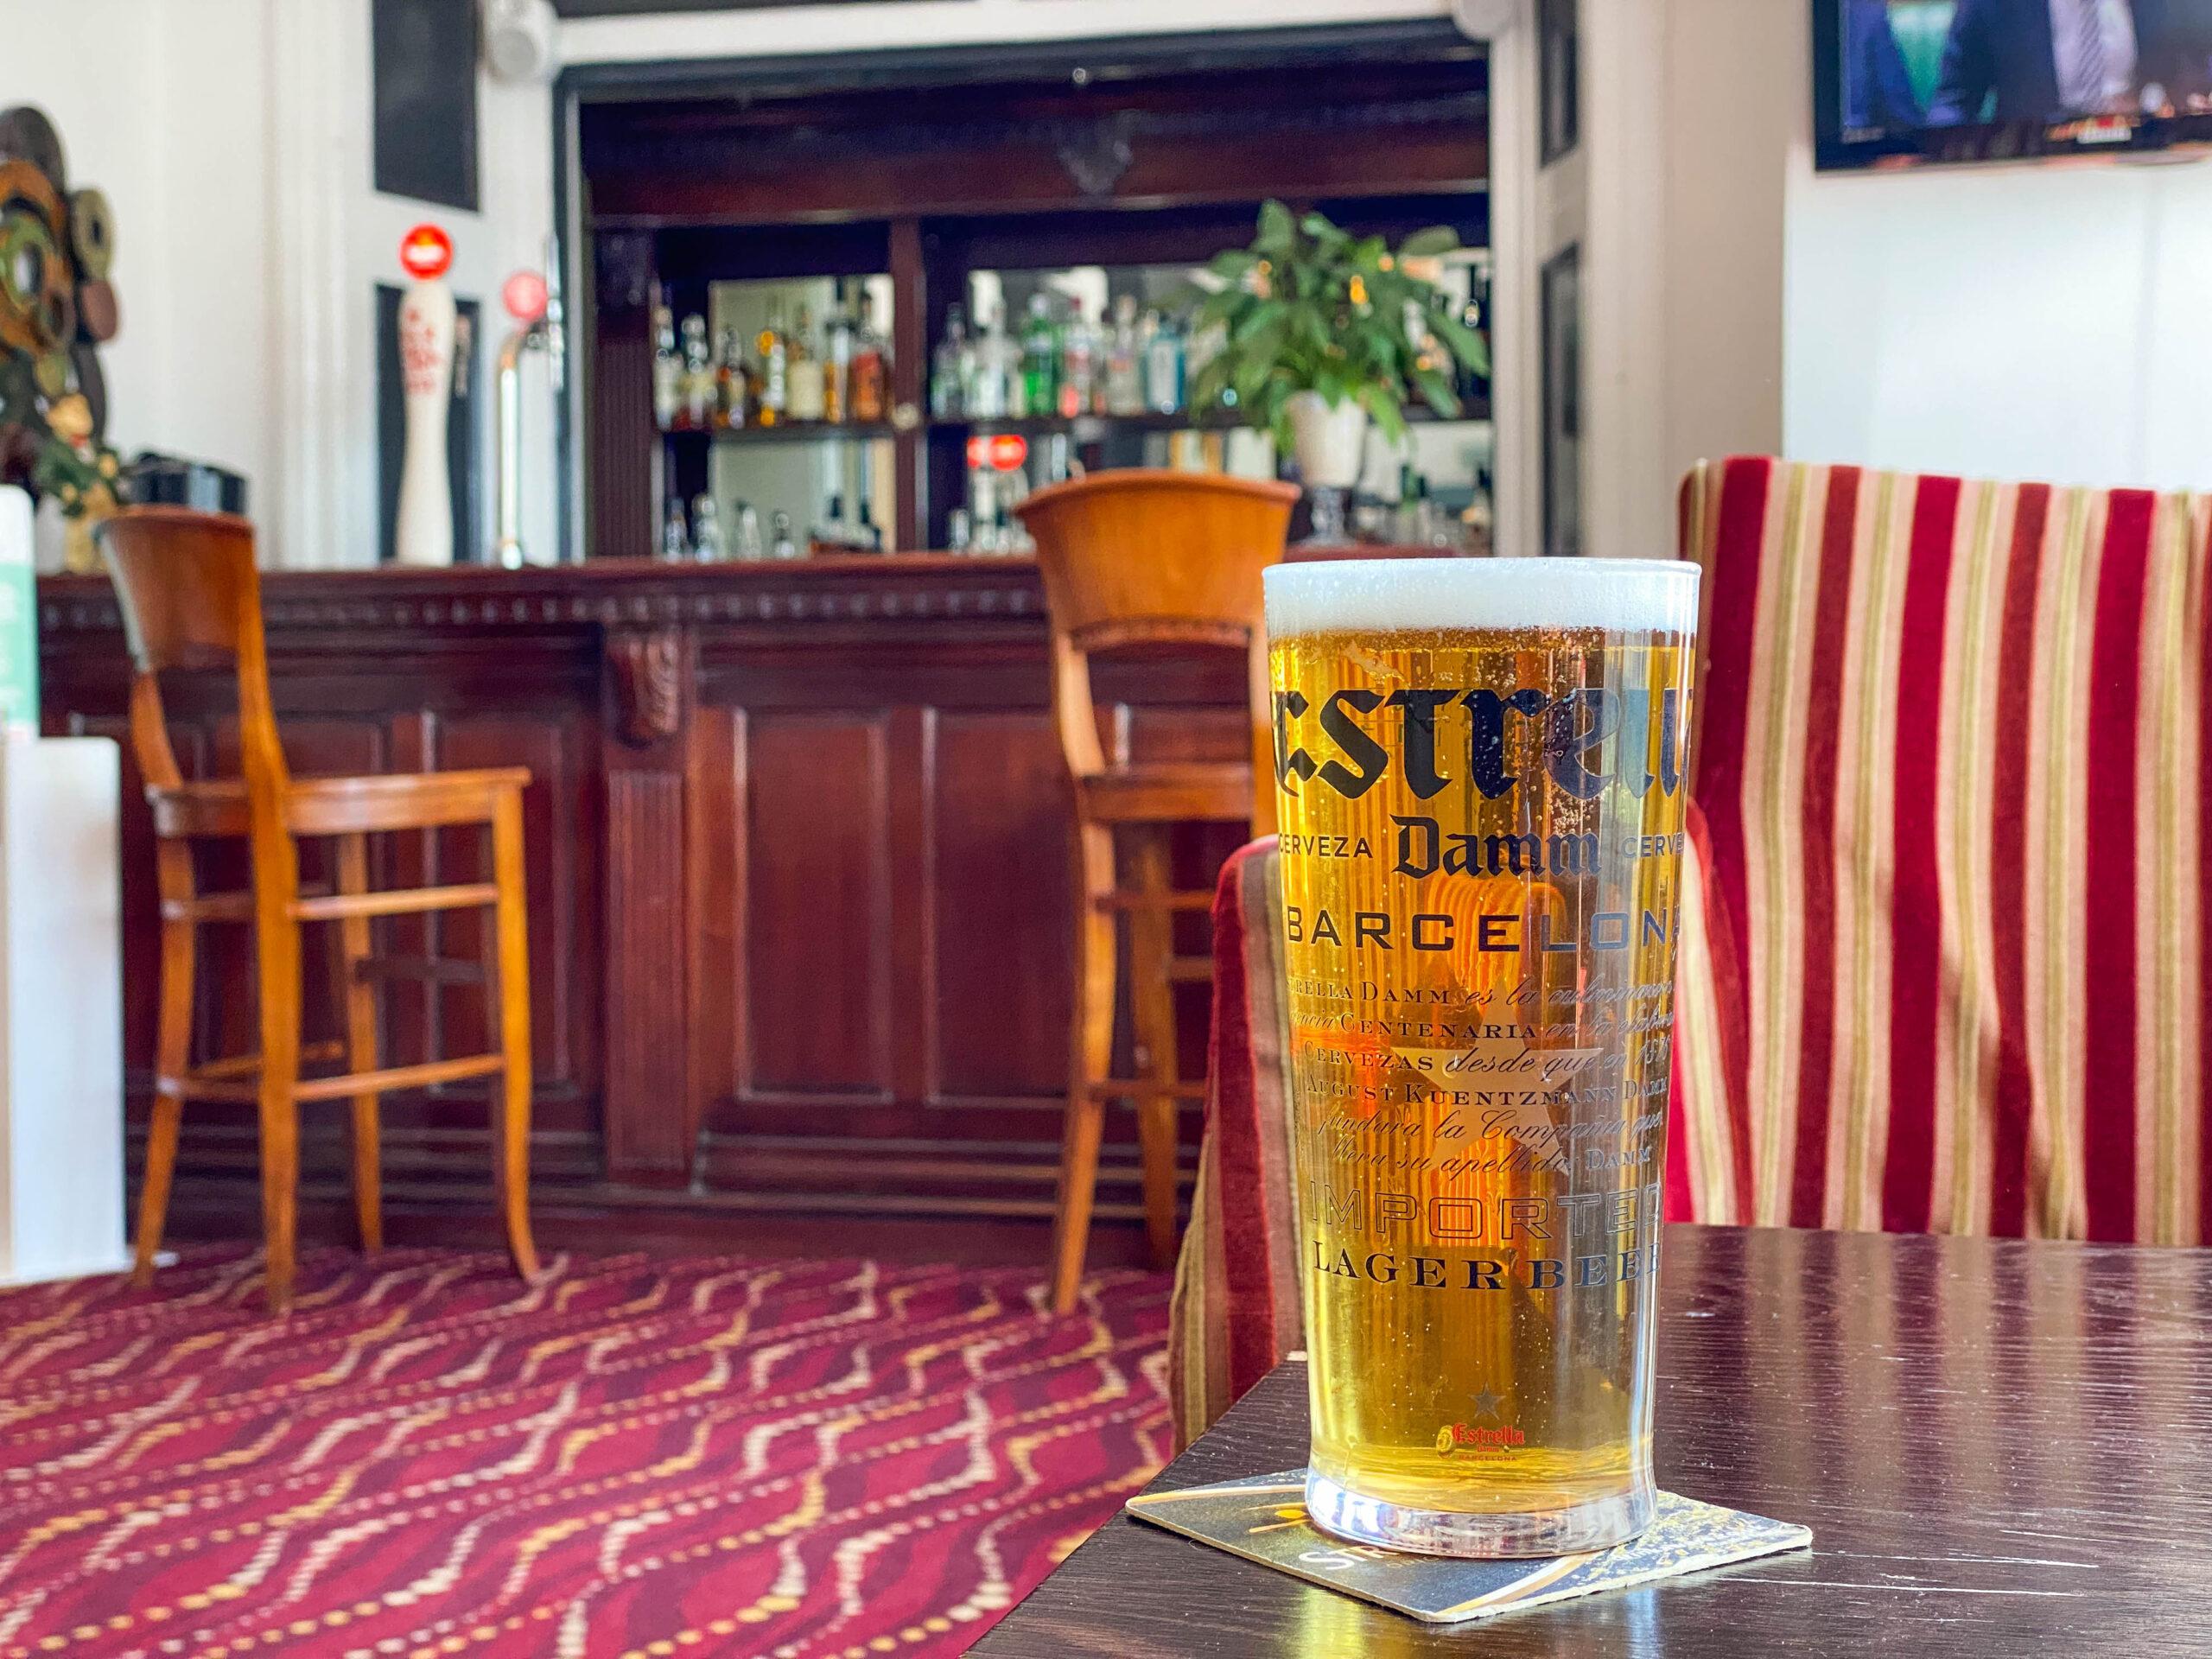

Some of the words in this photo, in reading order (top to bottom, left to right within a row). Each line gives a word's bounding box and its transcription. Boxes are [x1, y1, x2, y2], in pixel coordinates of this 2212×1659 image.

[1279, 832, 1373, 859] CERVEZA
[1389, 814, 1602, 879] Damm
[1360, 981, 1450, 1004] DAMM
[1465, 989, 1497, 1006] es
[1505, 975, 1541, 1006] la
[1340, 1013, 1536, 1039] CENTENARIA
[1304, 1039, 1433, 1071] CERVEZAS
[1445, 1046, 1536, 1074] desde
[1307, 1074, 1395, 1102] AUGUST
[1404, 1083, 1617, 1107] KUENTZMANN
[1433, 1109, 1469, 1140] la
[1586, 1146, 1651, 1171] DAMM
[1313, 1241, 1506, 1290] LAGER
[1452, 1422, 1526, 1446] Estrella
